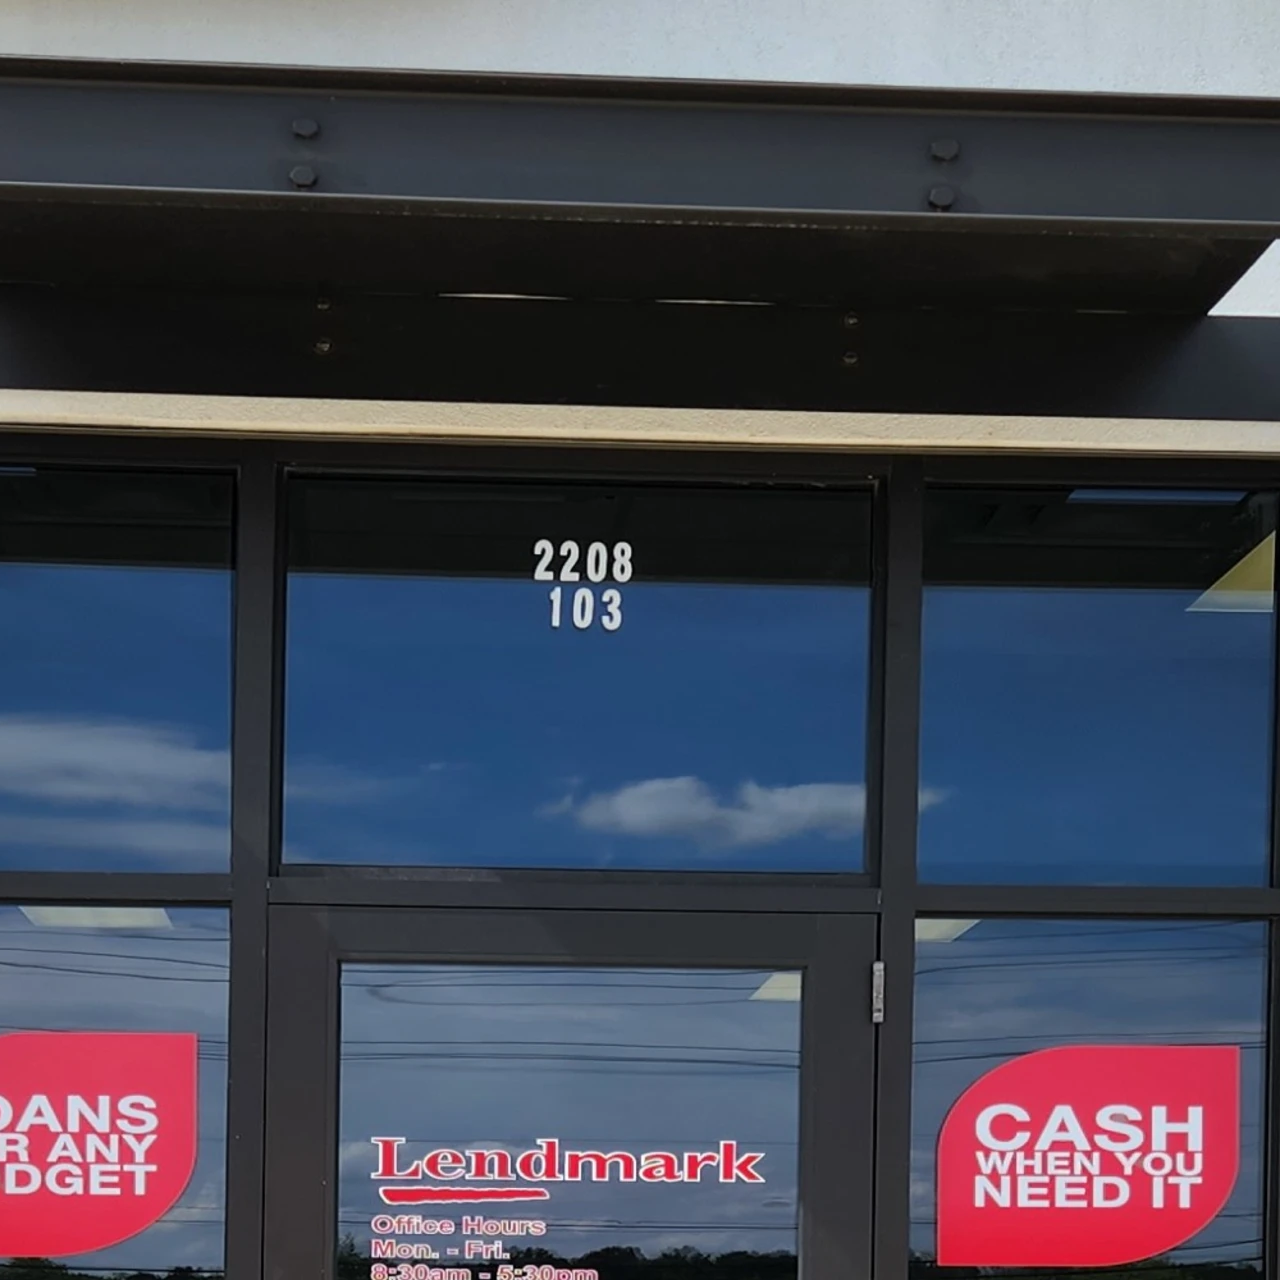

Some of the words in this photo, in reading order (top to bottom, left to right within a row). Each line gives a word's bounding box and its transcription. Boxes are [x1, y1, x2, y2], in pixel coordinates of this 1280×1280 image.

[533, 538, 633, 583] 2208
[549, 585, 622, 631] 103
[975, 1103, 1204, 1152] CASH
[46, 1133, 158, 1163] ANY
[370, 1136, 766, 1184] Lendmark
[975, 1151, 1101, 1175] WHEN
[1114, 1151, 1204, 1176] YOU
[974, 1175, 1131, 1209] NEED
[1152, 1175, 1203, 1209] IT
[371, 1214, 456, 1235] Office
[462, 1215, 548, 1236] Hours
[370, 1239, 440, 1259] Mon.
[446, 1247, 459, 1256] -
[464, 1240, 511, 1260] Fri.
[478, 1271, 491, 1280] -
